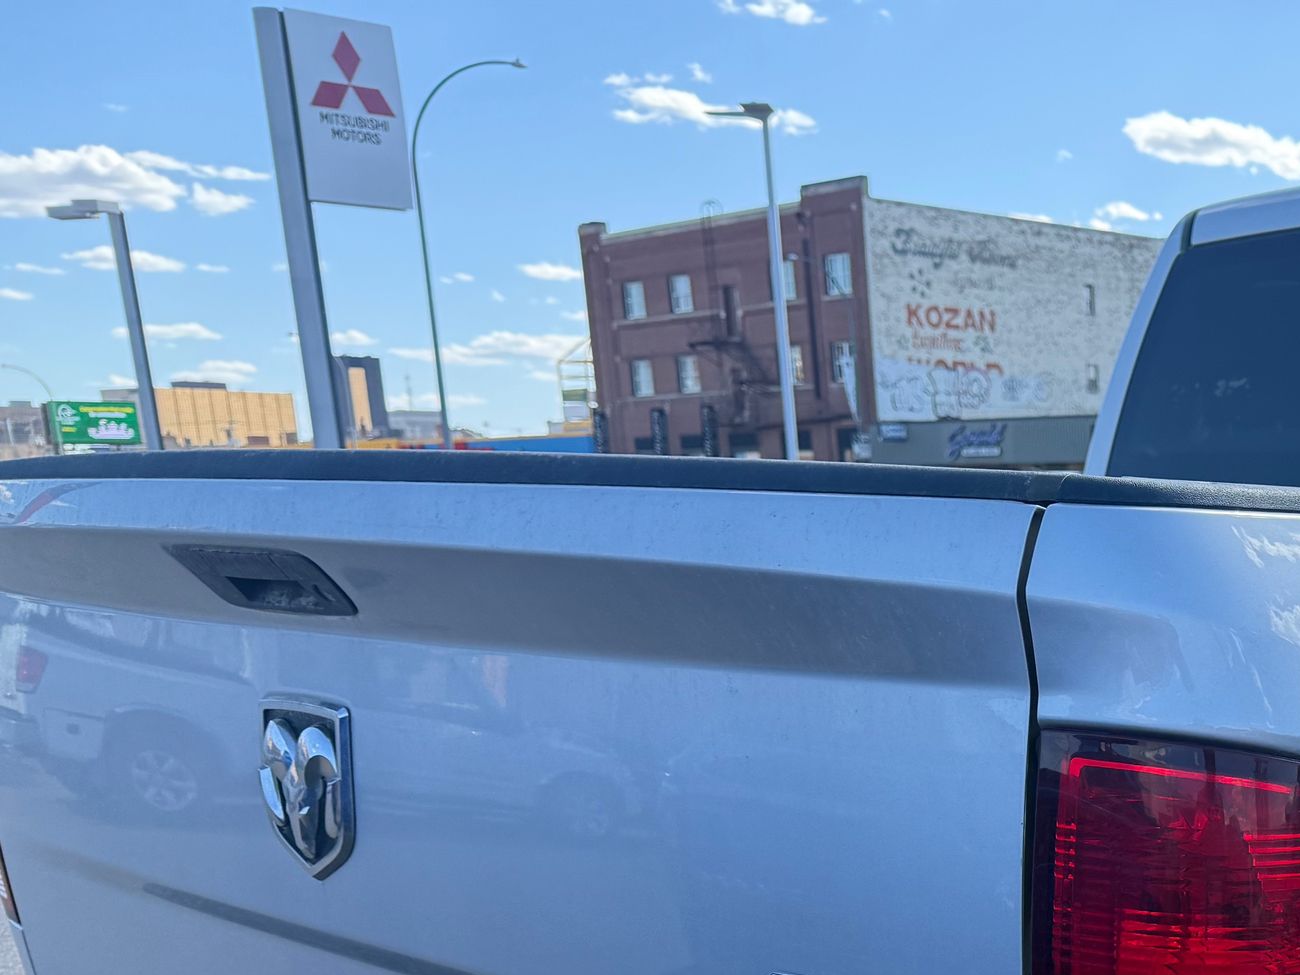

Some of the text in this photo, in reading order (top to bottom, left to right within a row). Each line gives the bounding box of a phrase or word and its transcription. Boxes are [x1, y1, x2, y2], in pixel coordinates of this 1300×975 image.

[320, 112, 390, 132] MITSUBISHI
[331, 128, 383, 145] MOTORS
[906, 303, 996, 333] KOZAN
